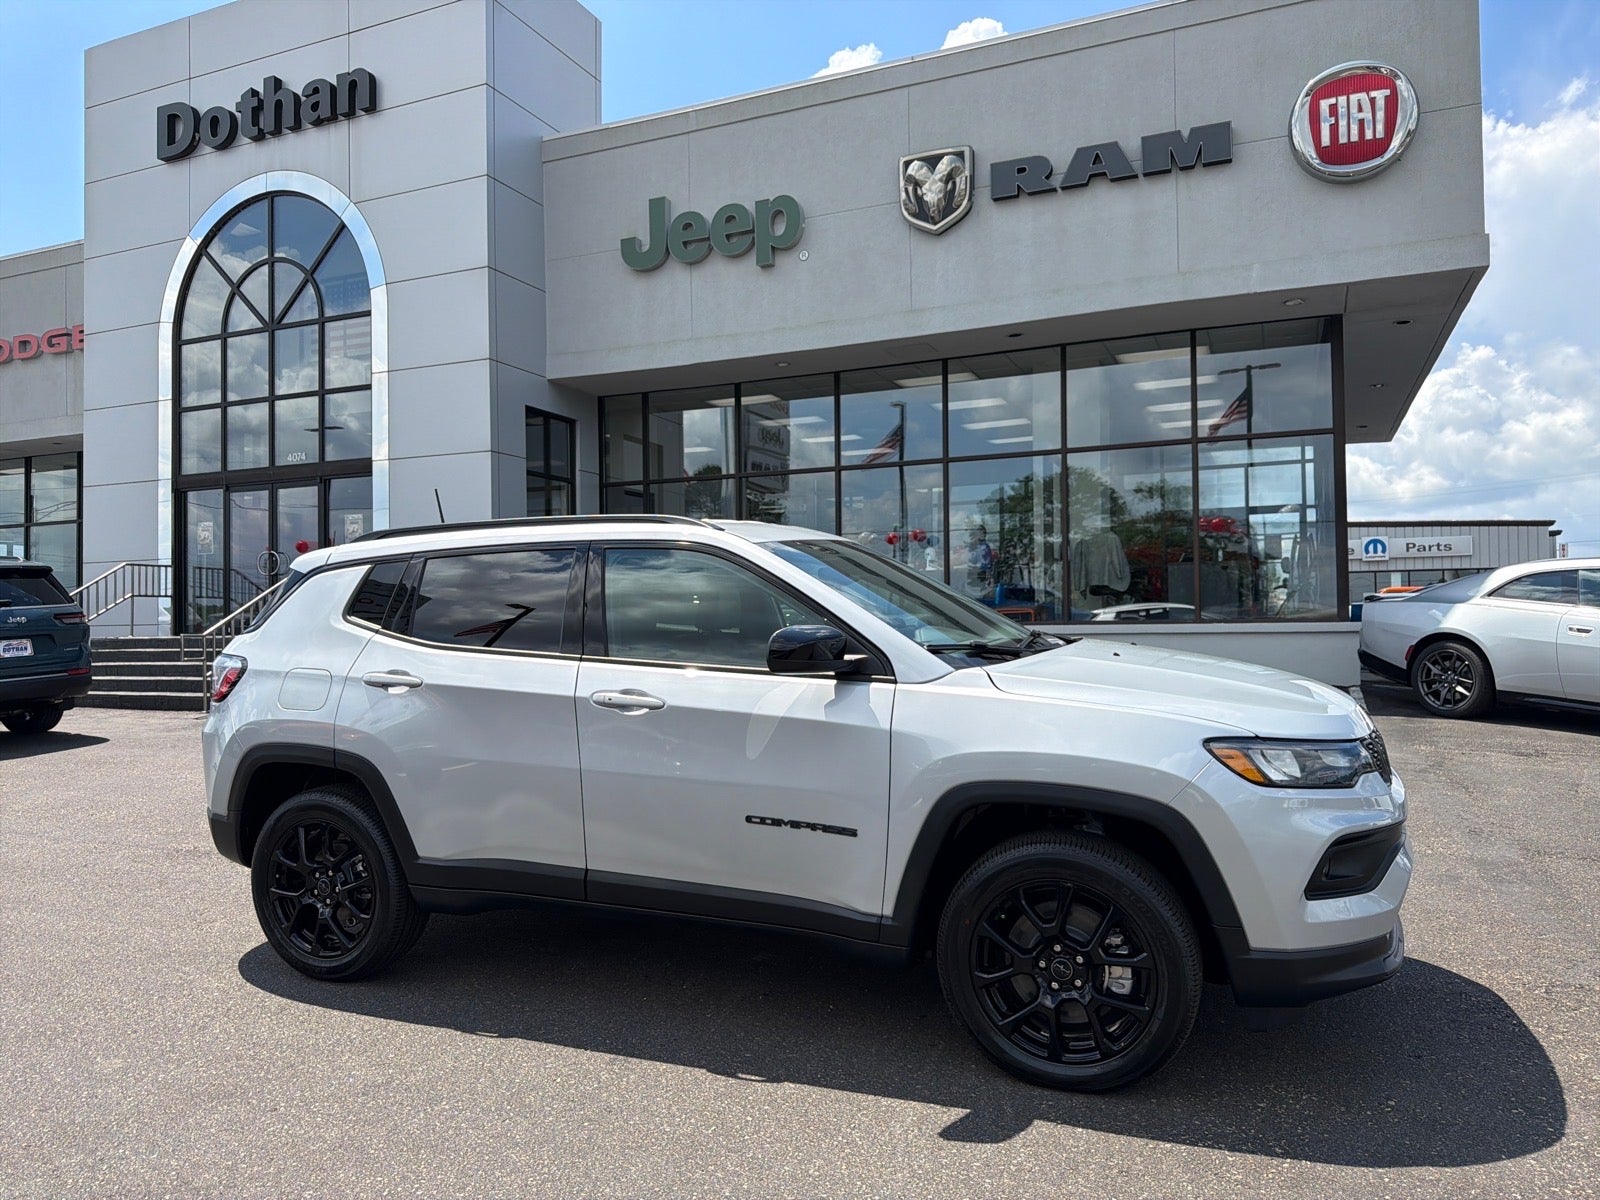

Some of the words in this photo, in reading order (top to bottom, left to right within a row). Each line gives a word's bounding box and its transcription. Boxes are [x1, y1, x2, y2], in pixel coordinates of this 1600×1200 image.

[157, 67, 377, 162] Dothan
[1318, 89, 1391, 148] FIAT
[990, 120, 1233, 202] RAM
[620, 194, 806, 272] Jeep
[287, 451, 306, 462] 4074
[1405, 542, 1453, 553] Parts
[7, 616, 28, 624] Jeep
[745, 814, 858, 837] COMPASS
